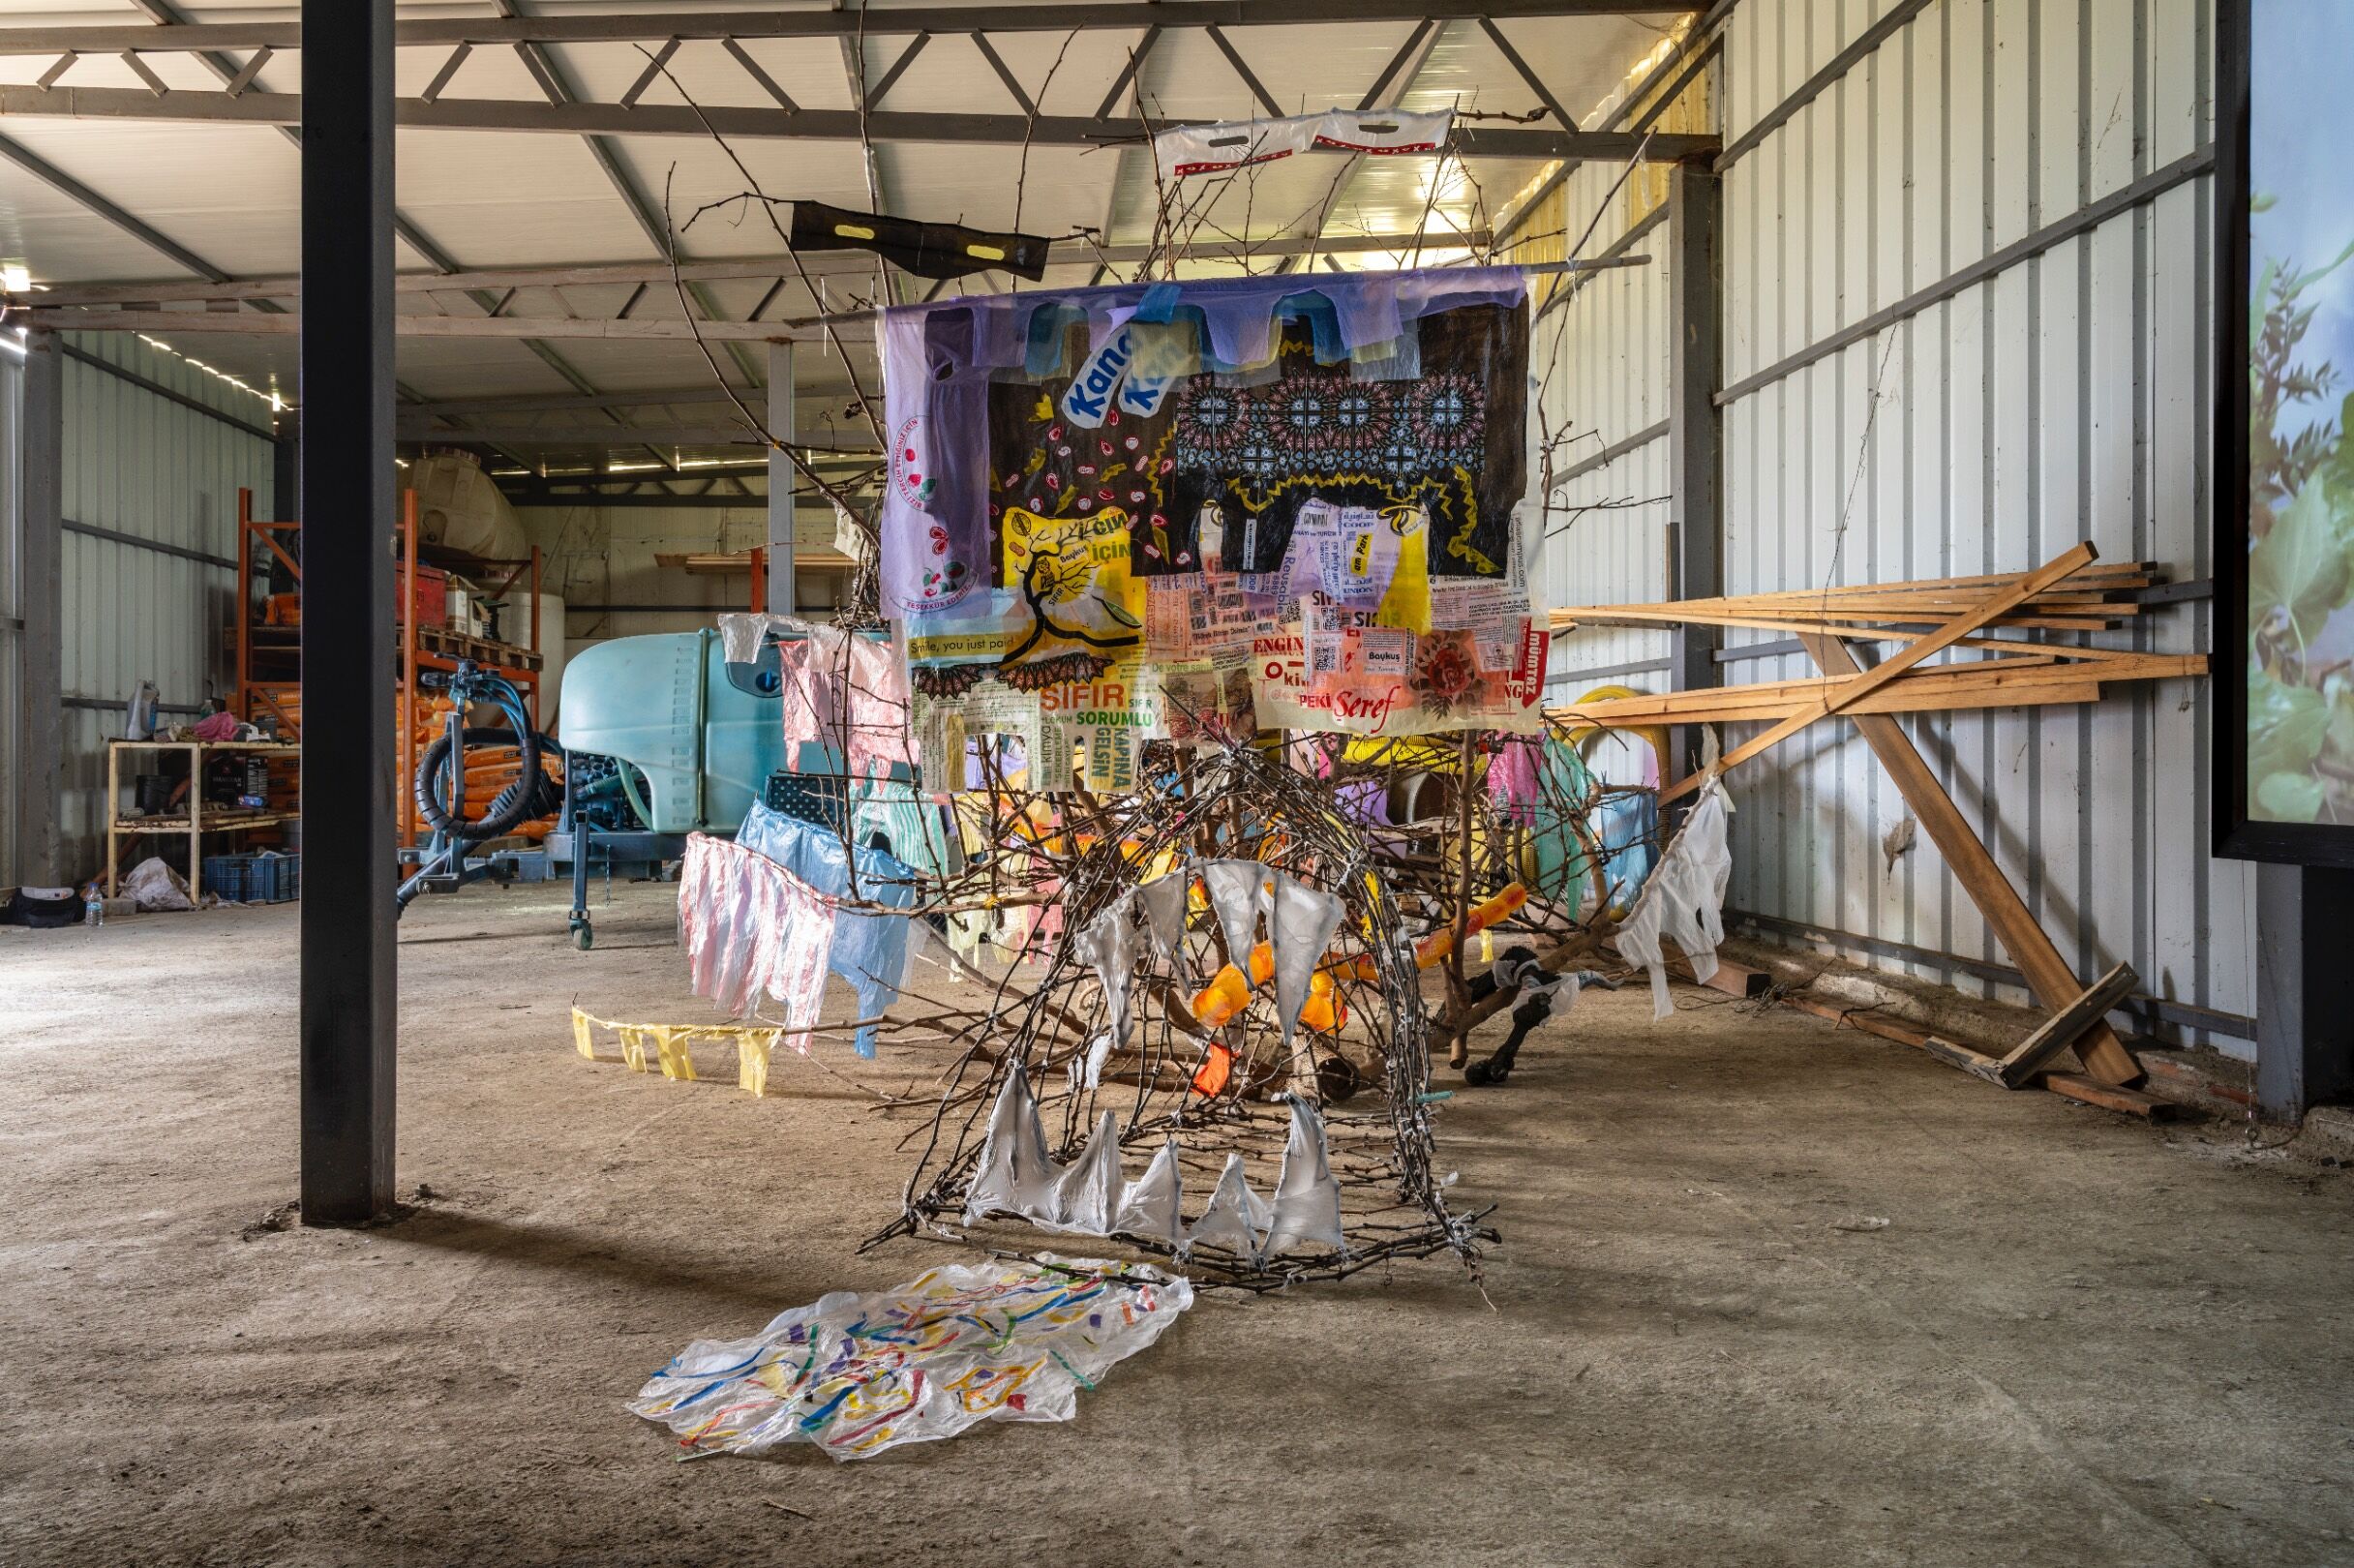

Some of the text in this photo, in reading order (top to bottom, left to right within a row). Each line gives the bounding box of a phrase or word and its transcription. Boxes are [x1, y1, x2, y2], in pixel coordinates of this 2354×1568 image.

[1356, 533, 1369, 555] Park
[1276, 557, 1296, 614] Reusable
[1048, 587, 1065, 607] SIFIR
[943, 642, 963, 652] you
[967, 639, 985, 652] just
[989, 637, 1014, 651] paid
[1369, 650, 1401, 663] Baykuş
[1152, 662, 1162, 672] De
[1166, 662, 1190, 672] votre
[1040, 683, 1125, 711] SIFIR
[1129, 699, 1153, 709] SIFR
[1075, 710, 1153, 728] SORUMLU
[1334, 685, 1402, 734] Şeref
